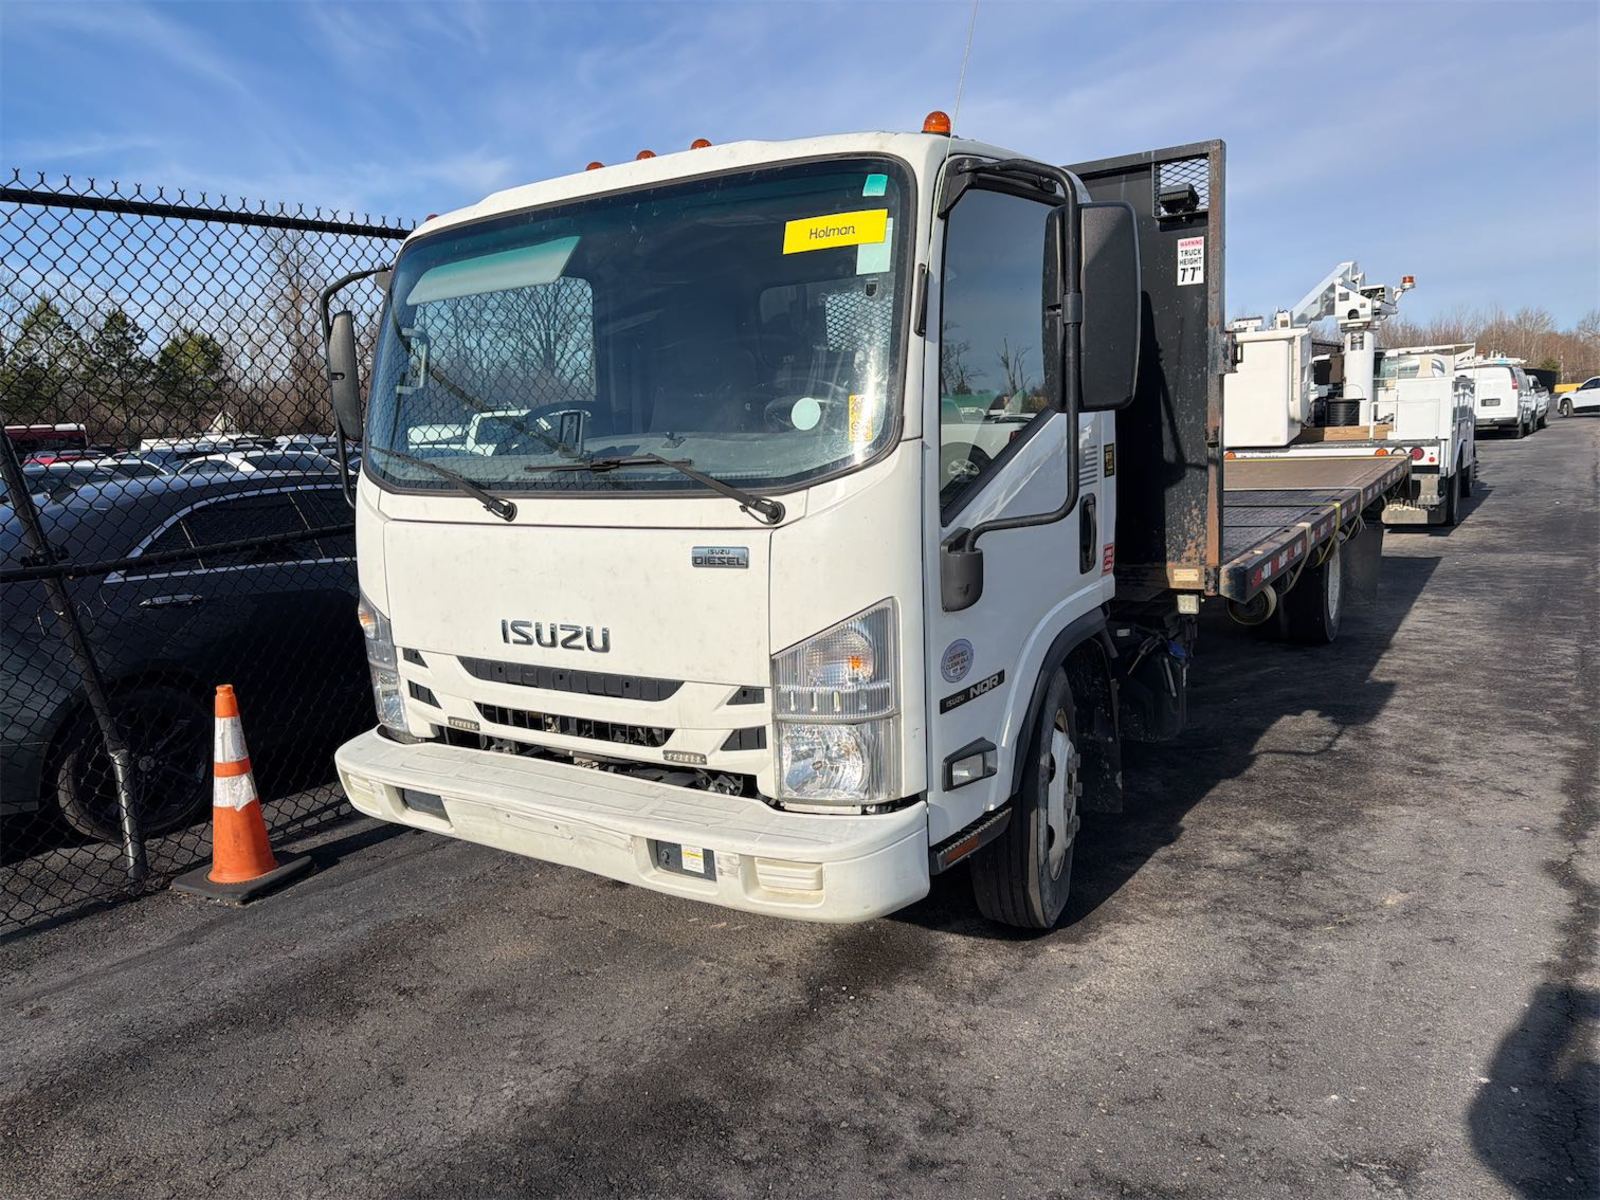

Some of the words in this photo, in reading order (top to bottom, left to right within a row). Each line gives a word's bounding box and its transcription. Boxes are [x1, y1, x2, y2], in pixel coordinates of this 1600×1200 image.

[809, 225, 856, 240] Holman
[1179, 239, 1203, 247] WARNING
[1180, 248, 1202, 257] TRUCK
[1179, 257, 1203, 266] HEIGHT
[693, 556, 746, 567] DIESEL
[501, 619, 611, 653] ISUZU
[945, 694, 965, 708] ISUZU
[969, 674, 999, 699] NQR
